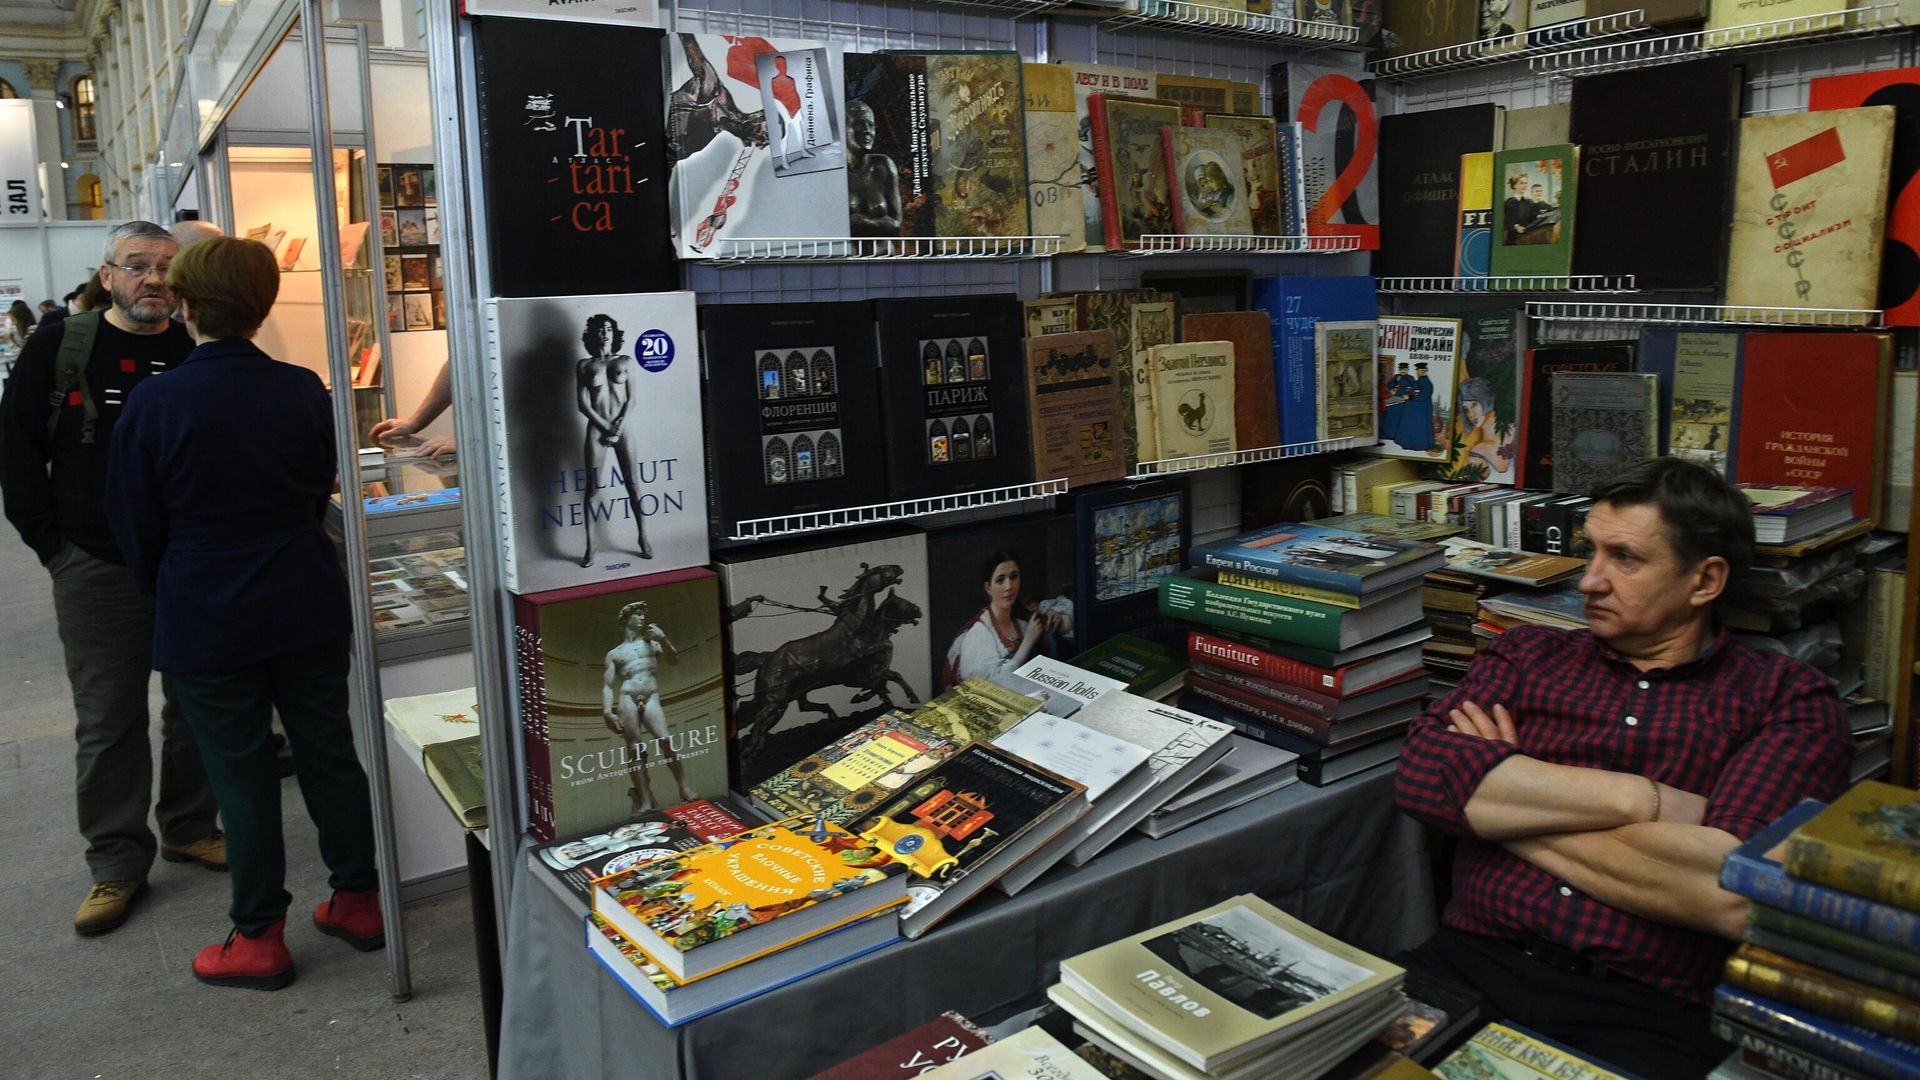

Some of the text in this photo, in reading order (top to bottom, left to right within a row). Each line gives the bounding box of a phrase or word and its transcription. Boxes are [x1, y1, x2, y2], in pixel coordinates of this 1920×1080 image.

[804, 57, 815, 99] Графика
[1585, 147, 1707, 177] СТАЛИН
[7, 179, 28, 214] ЗАЛ
[1402, 189, 1458, 202] ОФИЦЕР
[571, 201, 615, 232] ca
[1766, 200, 1816, 225] СТРОИТ
[1774, 219, 1852, 253] СОЦИАЛИЗМ
[1286, 296, 1302, 313] 27
[641, 337, 669, 356] 20
[1409, 353, 1452, 362] 1880-1917
[1410, 337, 1454, 352] ДИЗАЙН
[762, 402, 837, 418] ФЛОРЕНЦИЯ
[928, 386, 988, 406] ПАРИЖ
[1765, 442, 1849, 457] ГРАЖДАНСКОЙ
[1780, 431, 1833, 443] ИСТОРИЯ
[1784, 455, 1826, 467] ВОЙНЫ
[546, 459, 678, 495] HELMUT
[495, 443, 512, 563] NEWTON
[540, 490, 684, 530] NEWTON
[1205, 554, 1279, 577] Евреи в России
[1195, 636, 1260, 667] Furniture
[1025, 667, 1099, 700] Russian Dolls
[560, 725, 719, 780] SCULPTURE
[571, 748, 710, 787] FROM ANTIQUITY TO THE PRESENT
[727, 852, 796, 895] УКРАШЕНИЯ
[756, 843, 825, 884] СОВЕТСКИЕ
[1136, 969, 1211, 1018] Павлов
